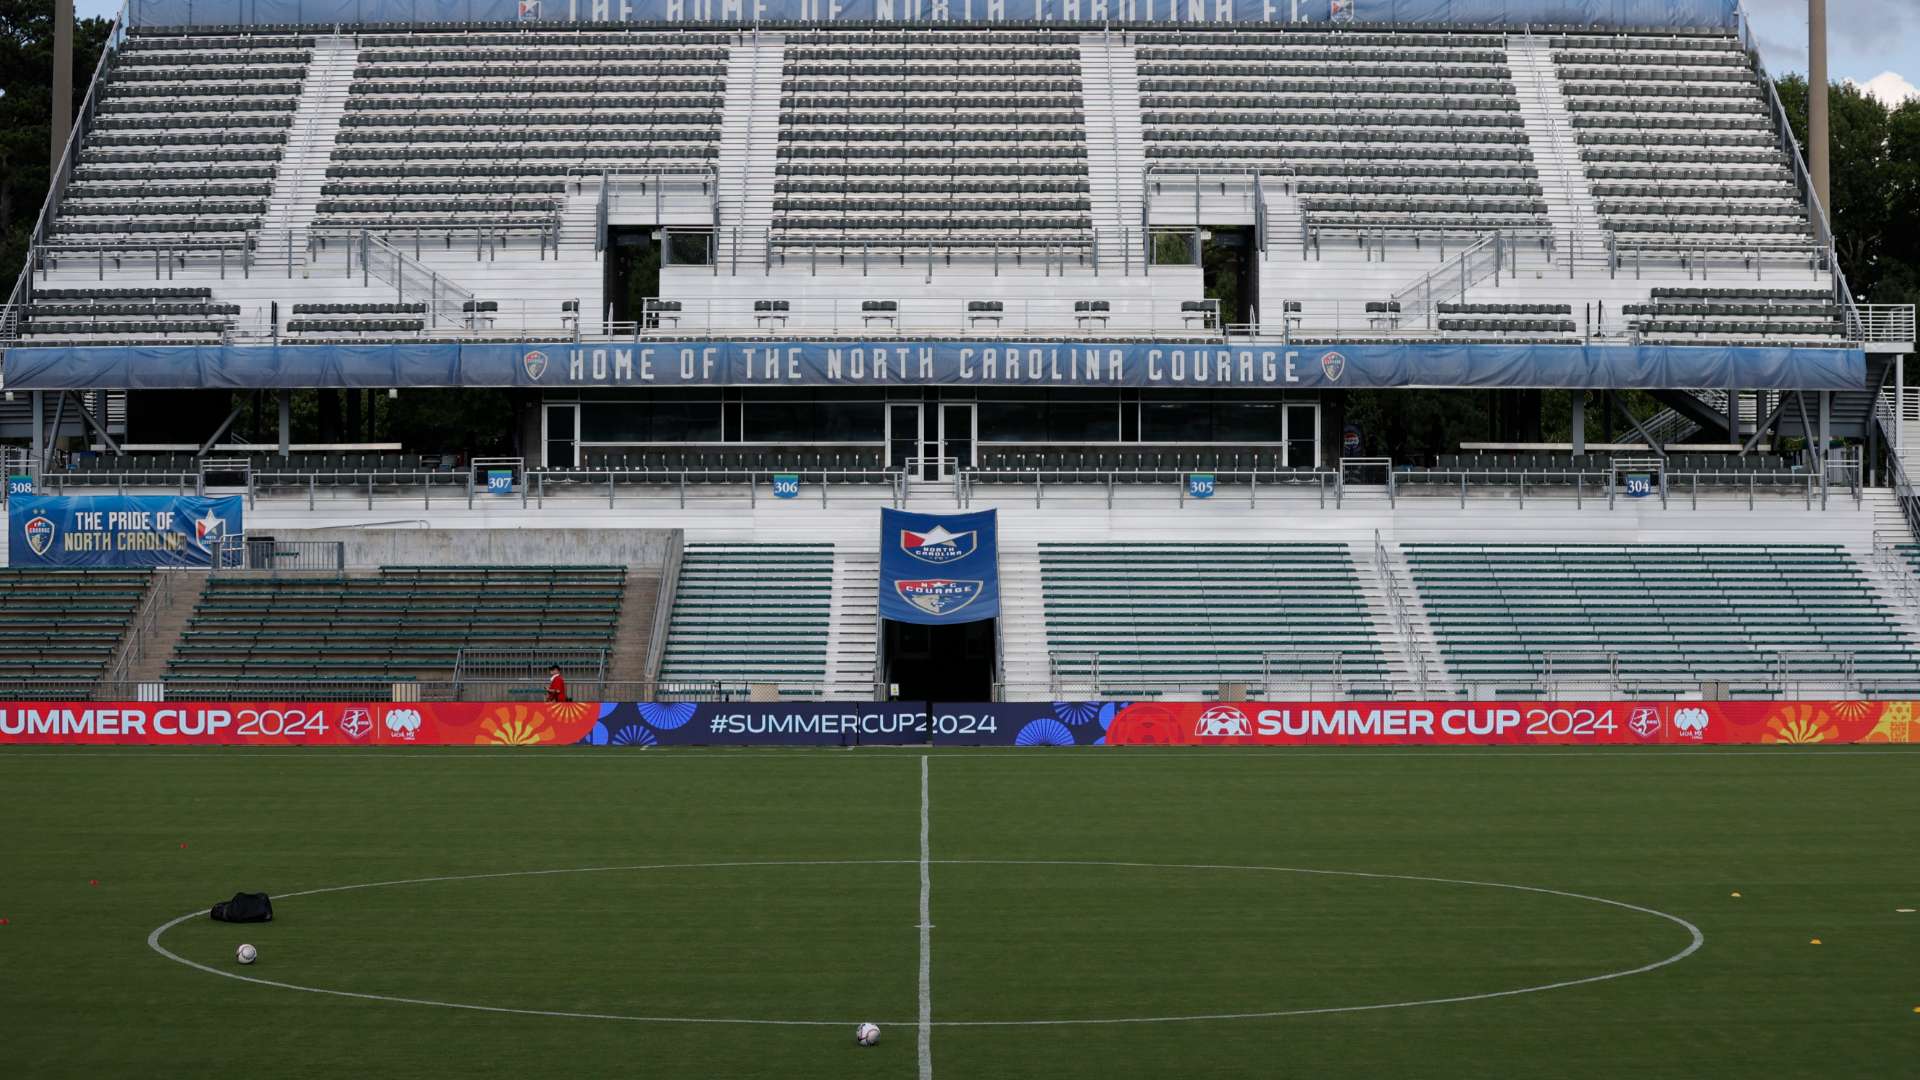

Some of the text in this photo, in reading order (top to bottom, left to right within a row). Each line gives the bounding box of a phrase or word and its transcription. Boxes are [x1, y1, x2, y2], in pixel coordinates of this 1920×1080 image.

[569, 347, 1300, 382] HOME OF THE NORTH CAROLINA COURAGE
[10, 482, 32, 494] 308
[488, 477, 512, 489] 307
[774, 481, 798, 494] 306
[1190, 481, 1214, 493] 305
[1628, 480, 1649, 494] 304
[75, 511, 175, 531] THE PRIDE OF
[64, 532, 112, 551] NORTH
[906, 586, 972, 594] COURAGE
[153, 709, 232, 735] CUP
[236, 709, 329, 736] 2024
[1257, 708, 1618, 736] SUMMER CUP 2024
